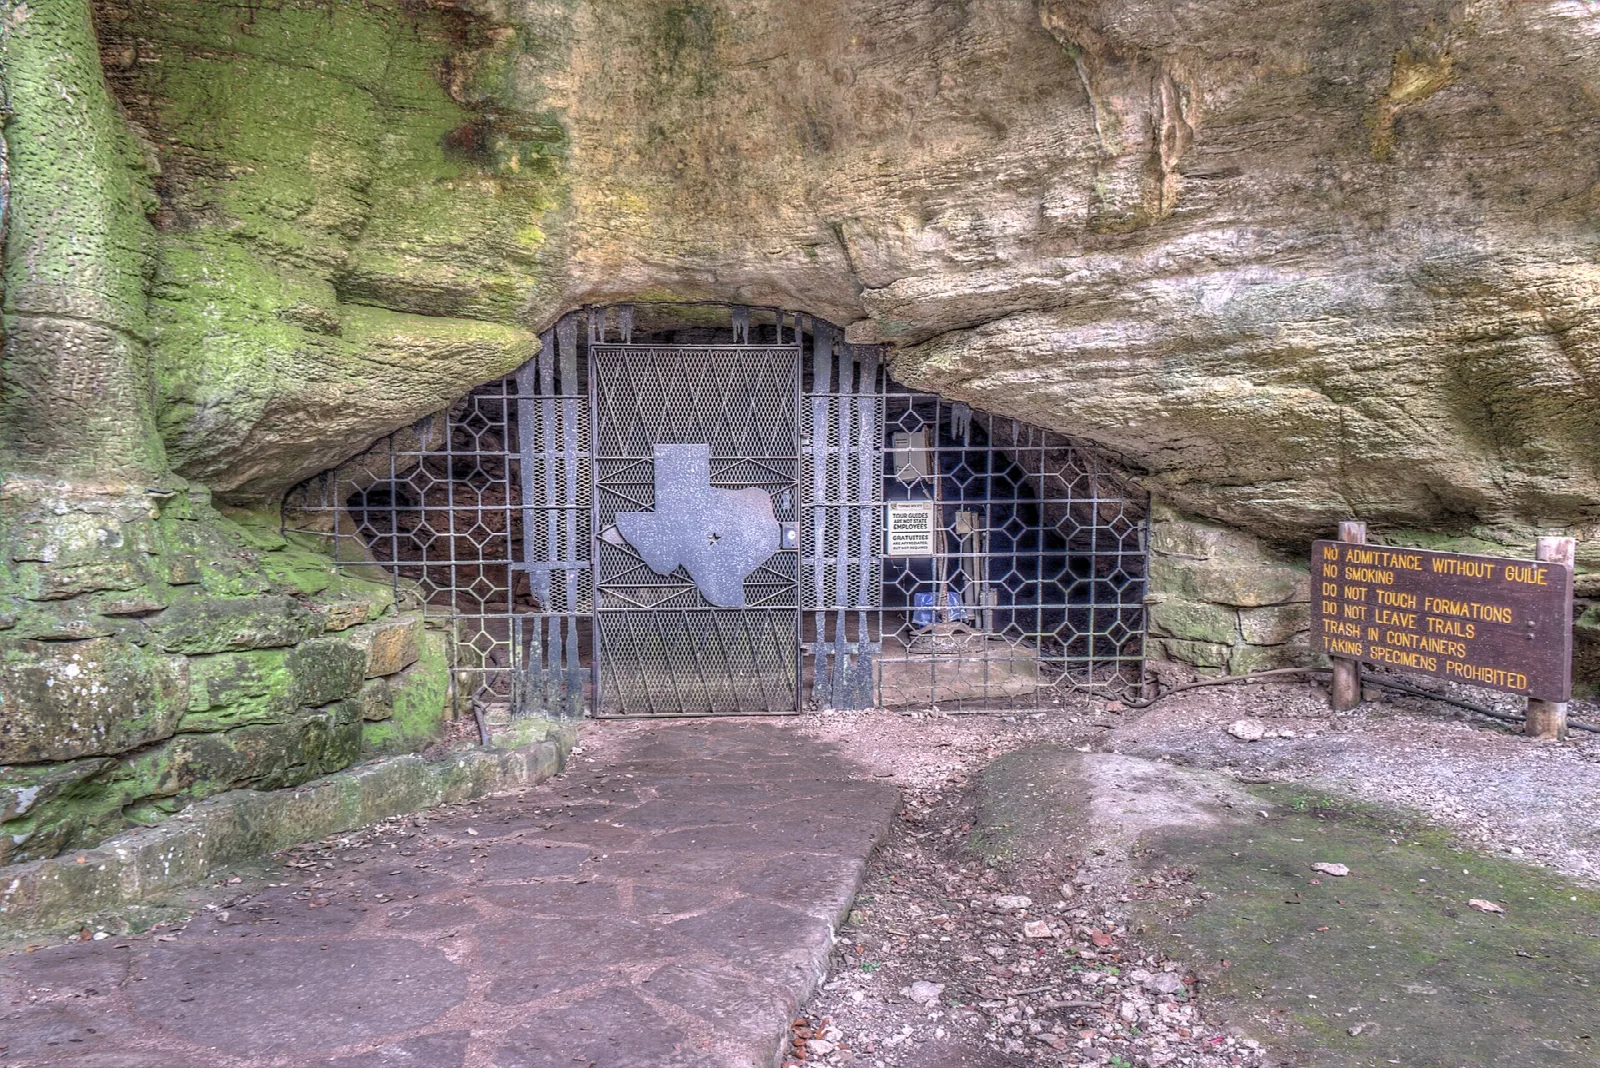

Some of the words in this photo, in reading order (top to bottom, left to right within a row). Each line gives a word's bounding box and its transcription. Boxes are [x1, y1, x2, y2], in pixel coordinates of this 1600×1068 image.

[1322, 564, 1338, 578] NO
[1345, 567, 1394, 585] SMOKING
[1323, 547, 1339, 561] NO
[1345, 549, 1423, 571] ADMITTANCE
[1432, 557, 1495, 579] WITHOUT
[1505, 565, 1548, 585] GUIDE
[1322, 582, 1338, 597] DO
[1344, 586, 1368, 601] NOT
[1376, 589, 1417, 609] TOUCH
[1424, 597, 1512, 624] FORMATIONS
[1322, 601, 1338, 615] DO
[1344, 605, 1368, 620] NOT
[1375, 608, 1417, 629] LEAVE
[1426, 617, 1475, 639] TRAILS
[1322, 618, 1361, 638] TRASH
[1367, 627, 1379, 641] IN
[1386, 630, 1466, 658] CONTAINERS
[1322, 636, 1362, 656] TAKING
[1370, 645, 1437, 672] SPECIMENS
[1446, 660, 1528, 690] PROHIBITED
